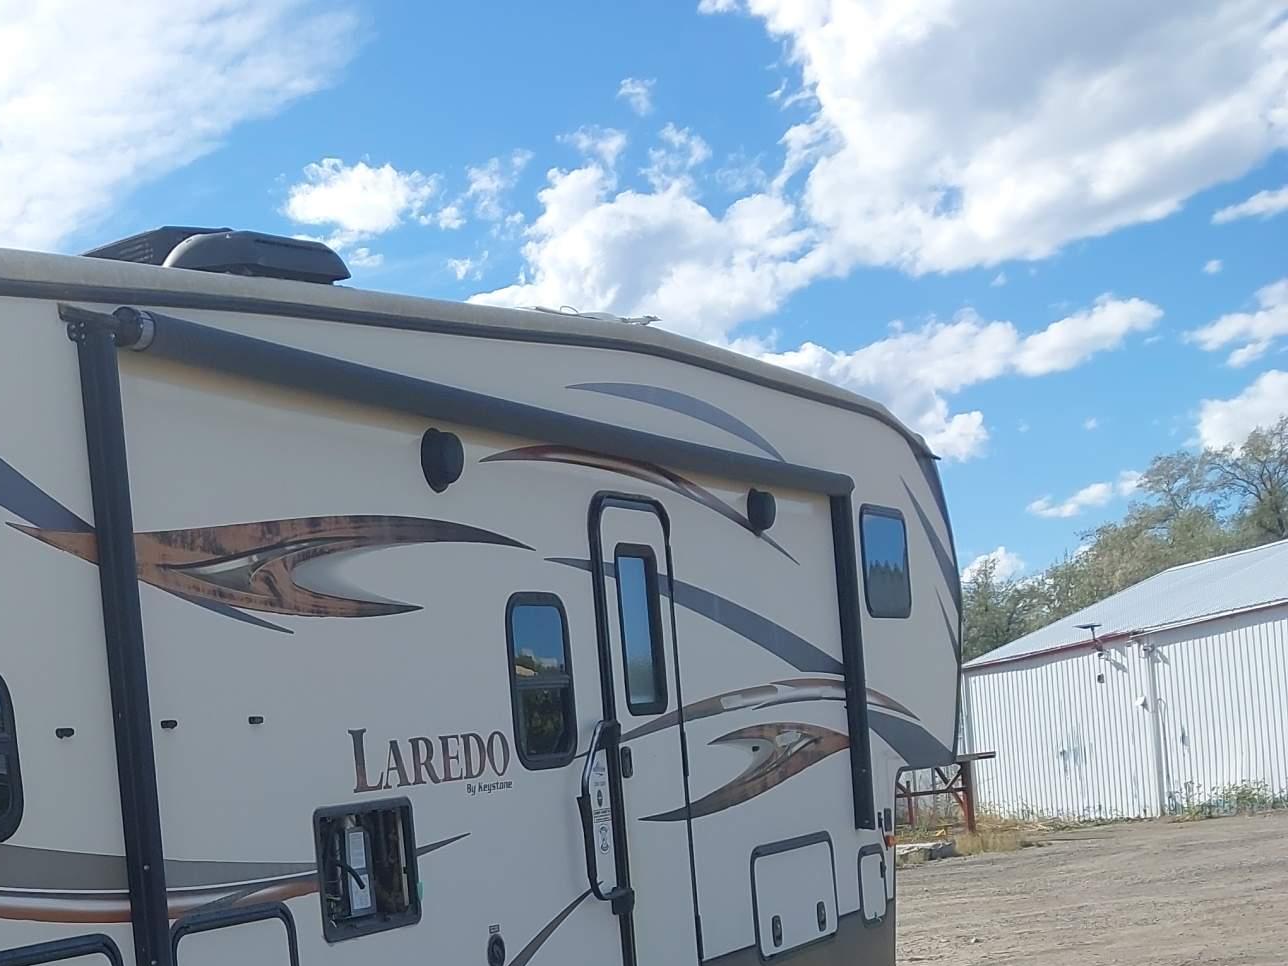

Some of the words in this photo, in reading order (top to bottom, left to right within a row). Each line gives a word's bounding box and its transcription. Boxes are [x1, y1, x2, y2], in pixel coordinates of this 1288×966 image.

[348, 728, 510, 793] LAREDO
[466, 783, 476, 796] By
[478, 781, 513, 794] Keystone
